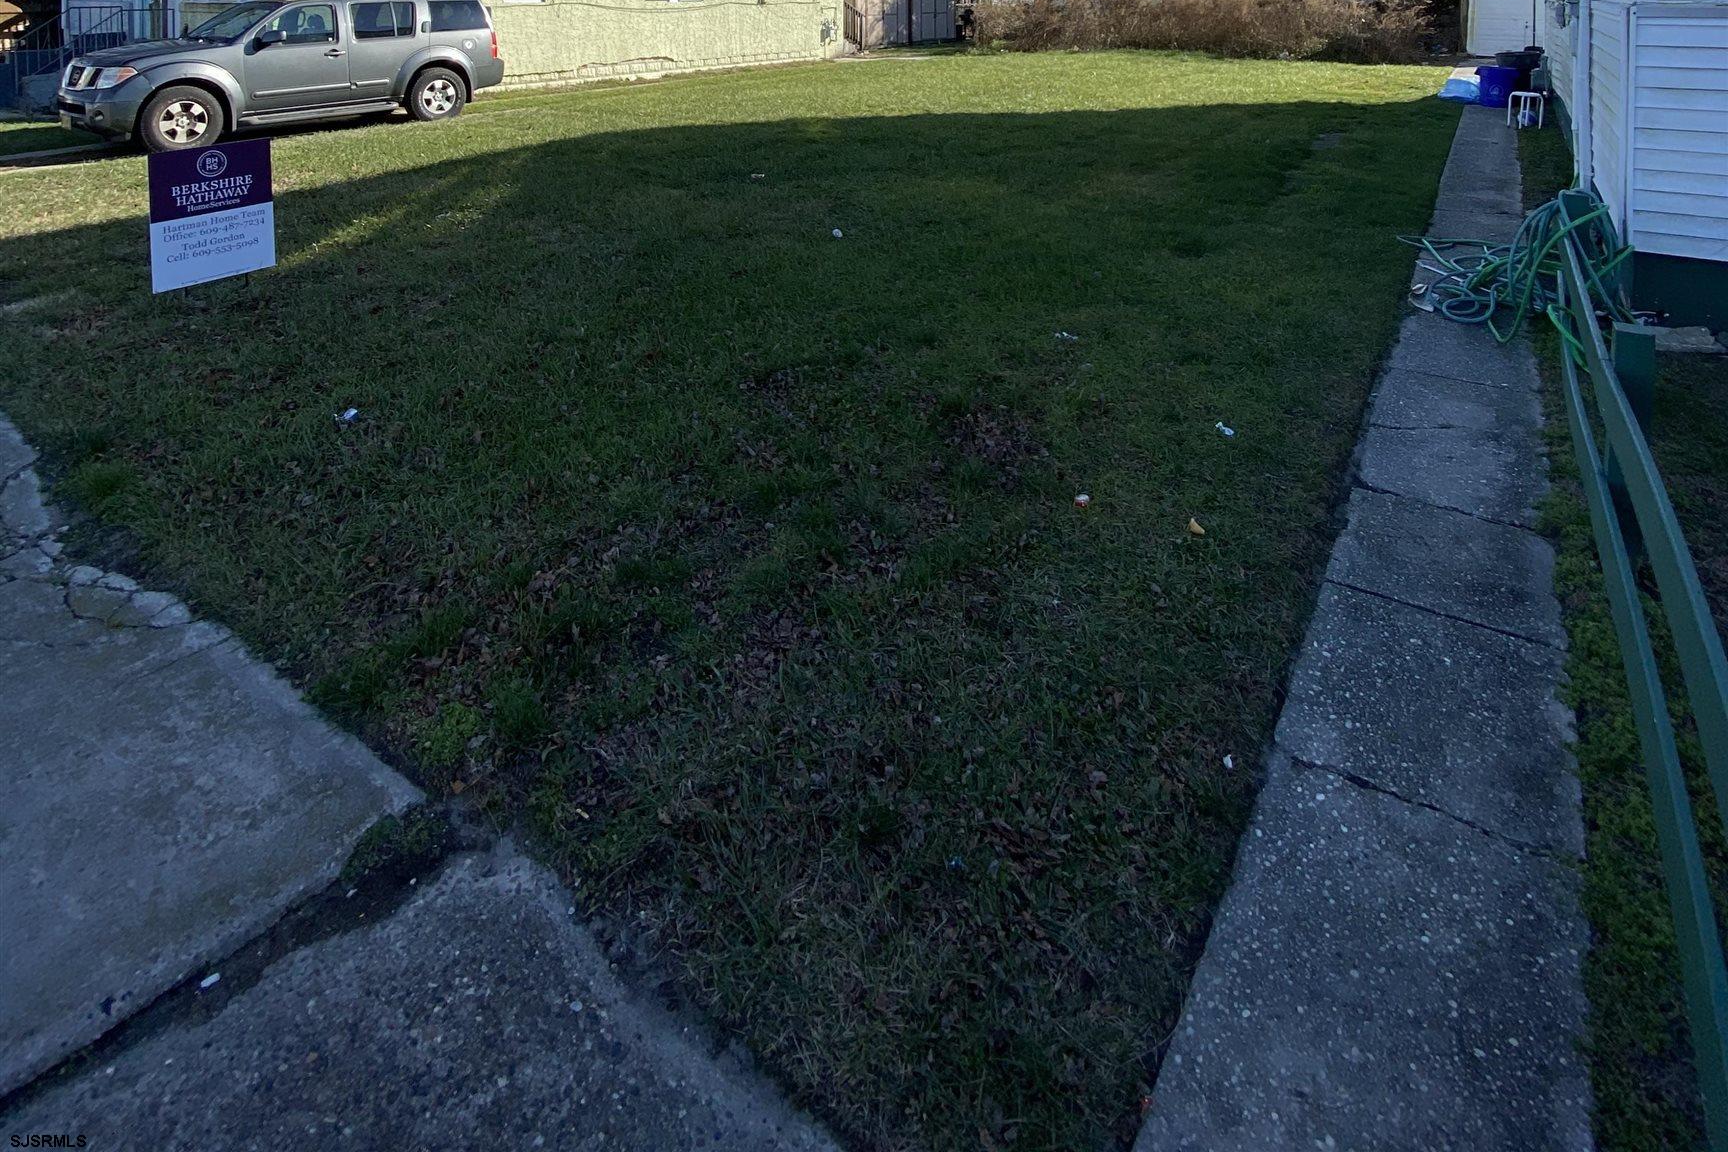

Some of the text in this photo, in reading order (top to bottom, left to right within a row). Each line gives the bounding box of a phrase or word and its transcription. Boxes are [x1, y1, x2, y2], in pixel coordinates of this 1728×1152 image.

[206, 157, 218, 165] BH
[206, 163, 218, 171] HS
[171, 175, 253, 197] BERKSHIRE
[176, 185, 250, 206] HATHAWAY
[187, 198, 240, 212] HomeServices
[162, 209, 265, 234] Hartman Home Team
[163, 230, 196, 243] Office:
[181, 233, 245, 251] Todd Gordon
[167, 237, 259, 263] Cell: 609-553-5098
